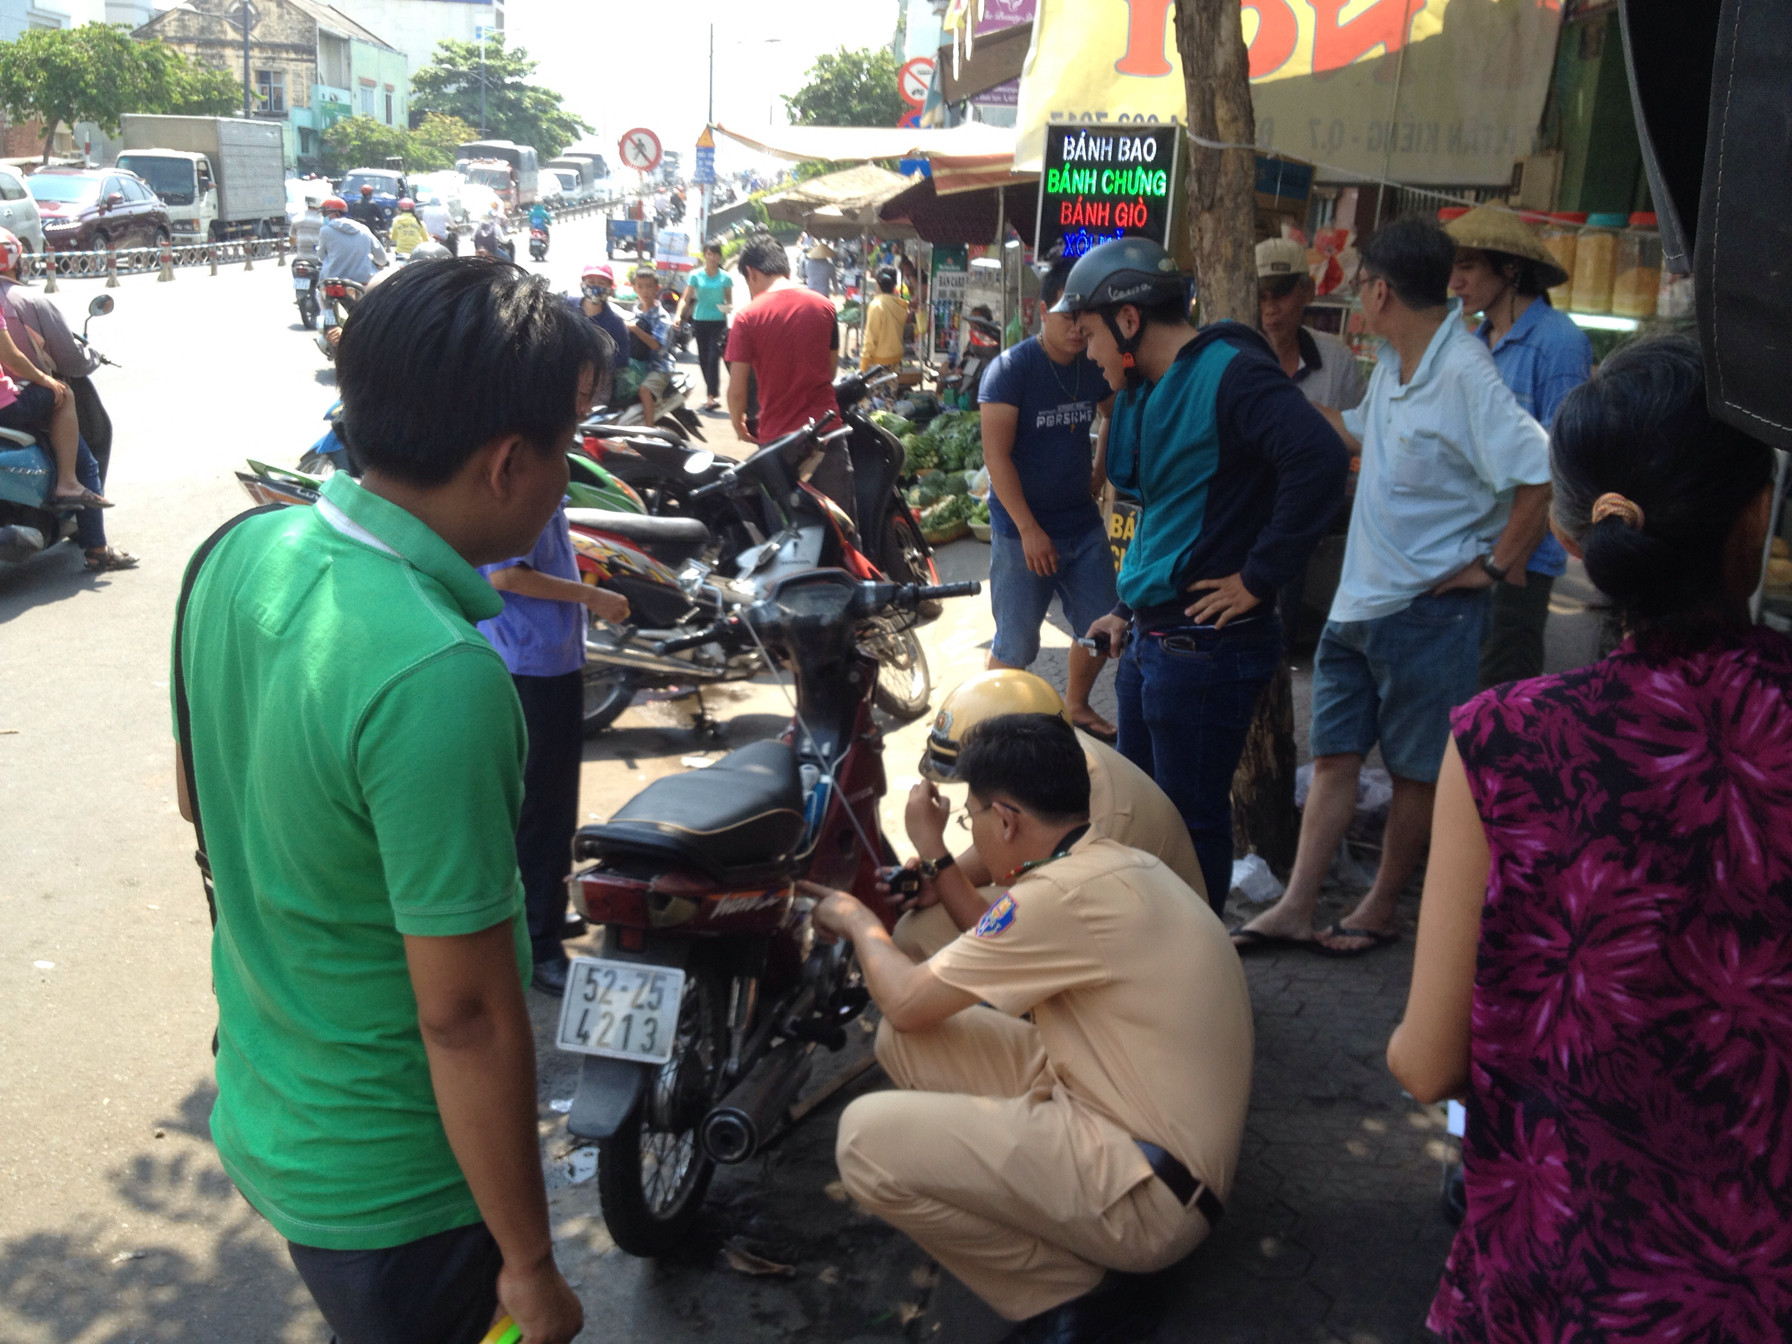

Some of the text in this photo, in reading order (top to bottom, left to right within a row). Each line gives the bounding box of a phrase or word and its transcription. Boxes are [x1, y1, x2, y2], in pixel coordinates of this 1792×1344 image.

[1063, 129, 1157, 162] BÁNH BAO
[1047, 162, 1167, 196] BÁNH CHƯNG
[1060, 195, 1148, 227] BÁNH GIÒ
[1110, 510, 1136, 540] BÁ
[576, 1008, 658, 1054] 4213
